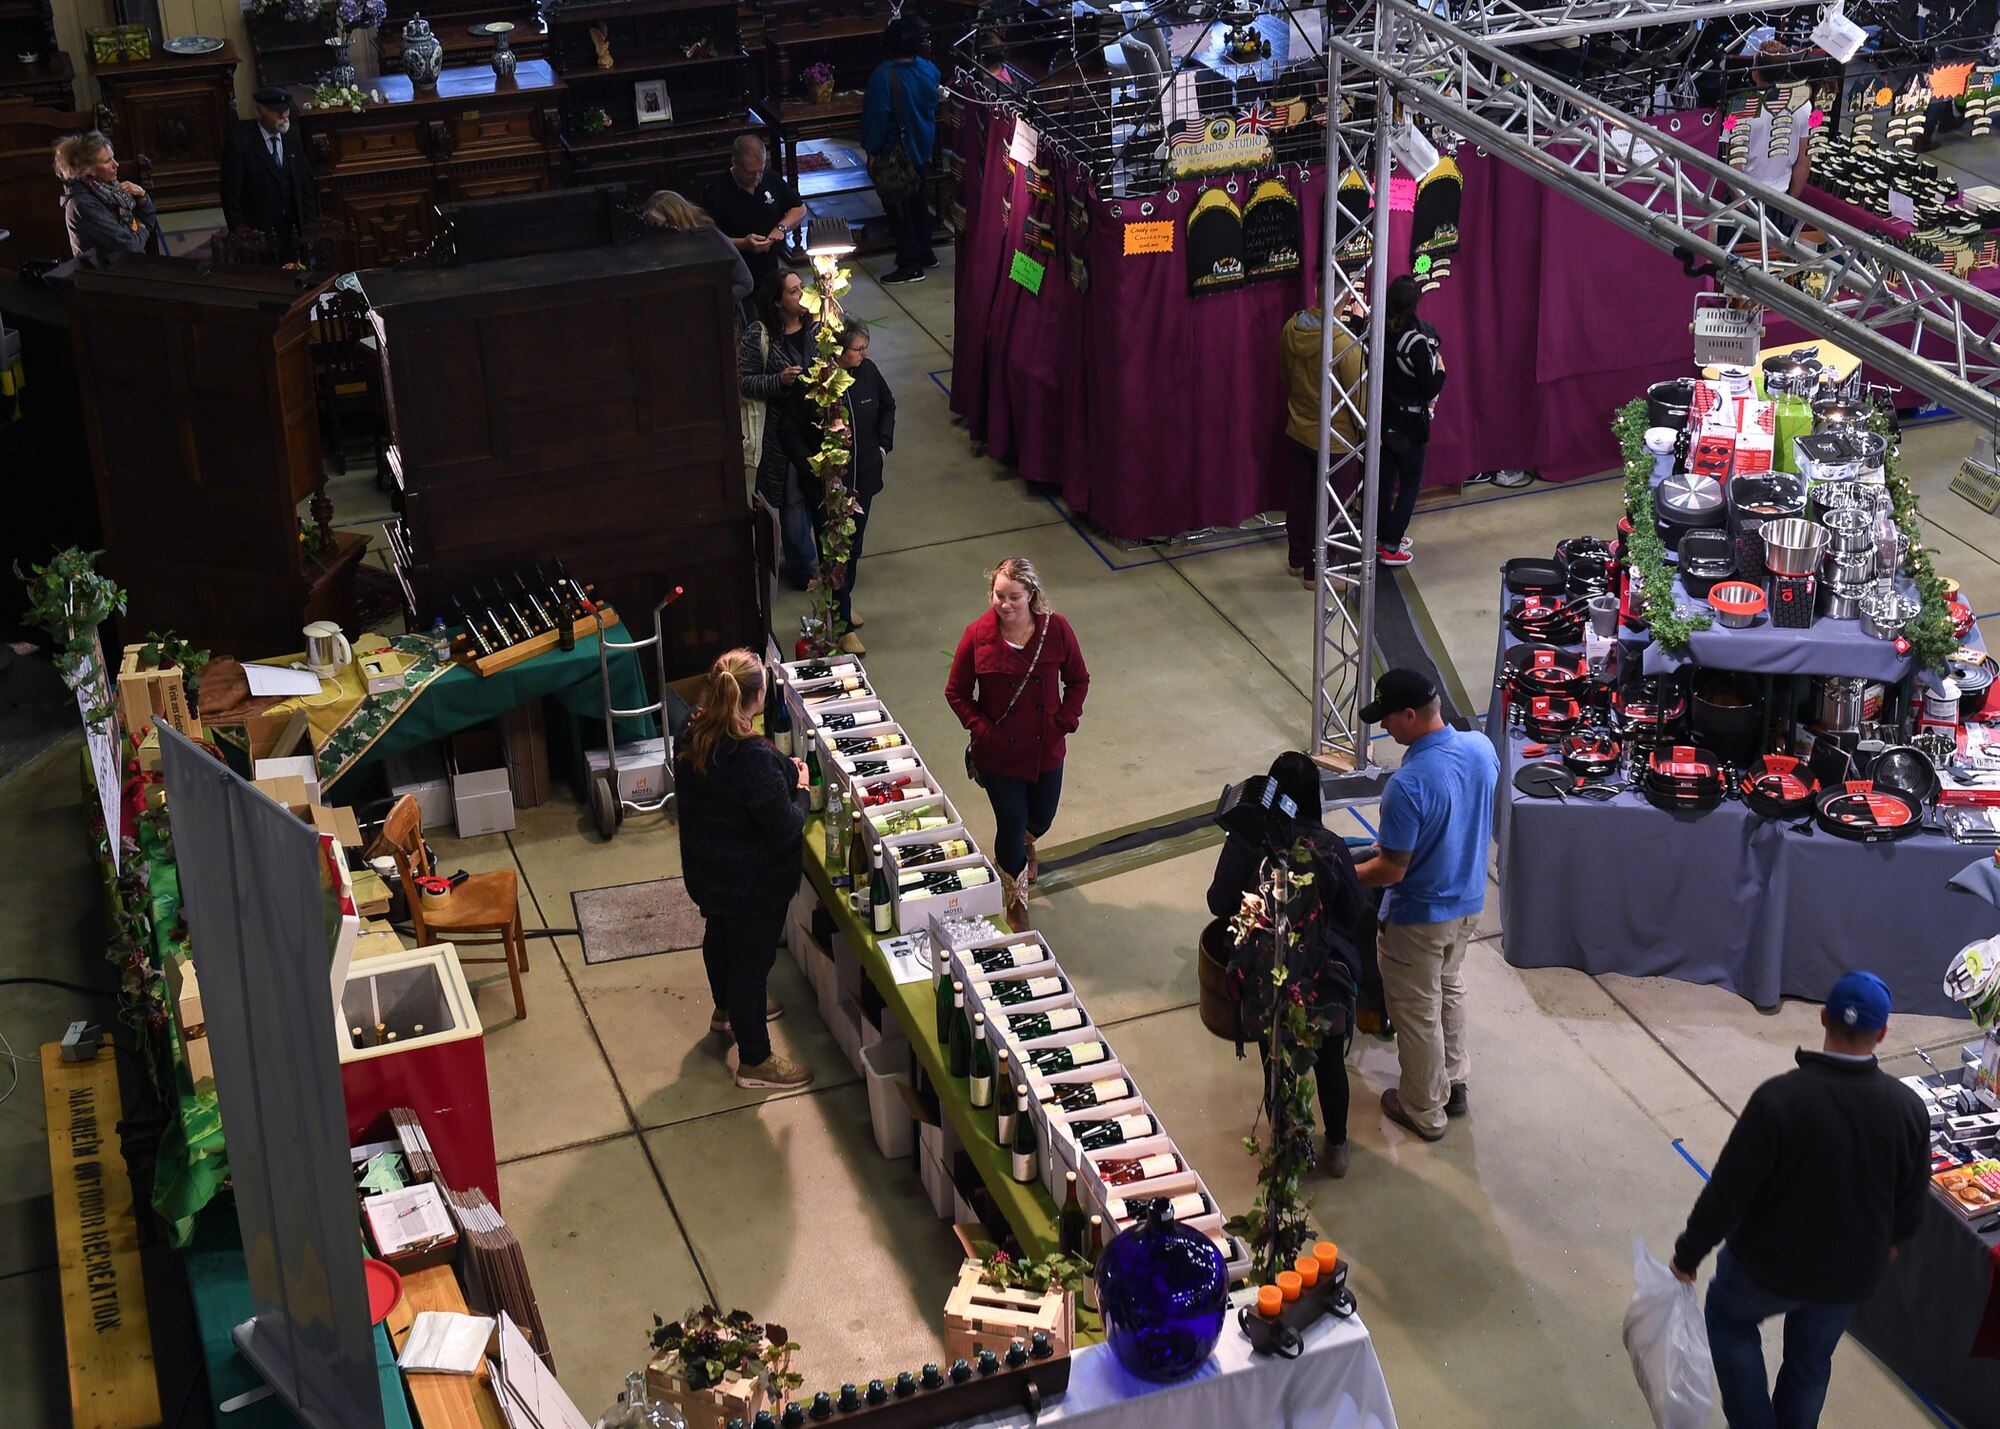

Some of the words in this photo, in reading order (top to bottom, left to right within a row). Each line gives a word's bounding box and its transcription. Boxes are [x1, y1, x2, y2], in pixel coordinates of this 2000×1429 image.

[1172, 141, 1224, 158] WOODLANDS
[1228, 136, 1262, 150] STUDIO
[168, 684, 178, 702] Wein
[171, 702, 180, 714] aus
[944, 907, 963, 916] MOSEL
[69, 1086, 99, 1158] MANNHEIM
[74, 1161, 106, 1230] OUTDOOR
[81, 1230, 122, 1334] RECREATION
